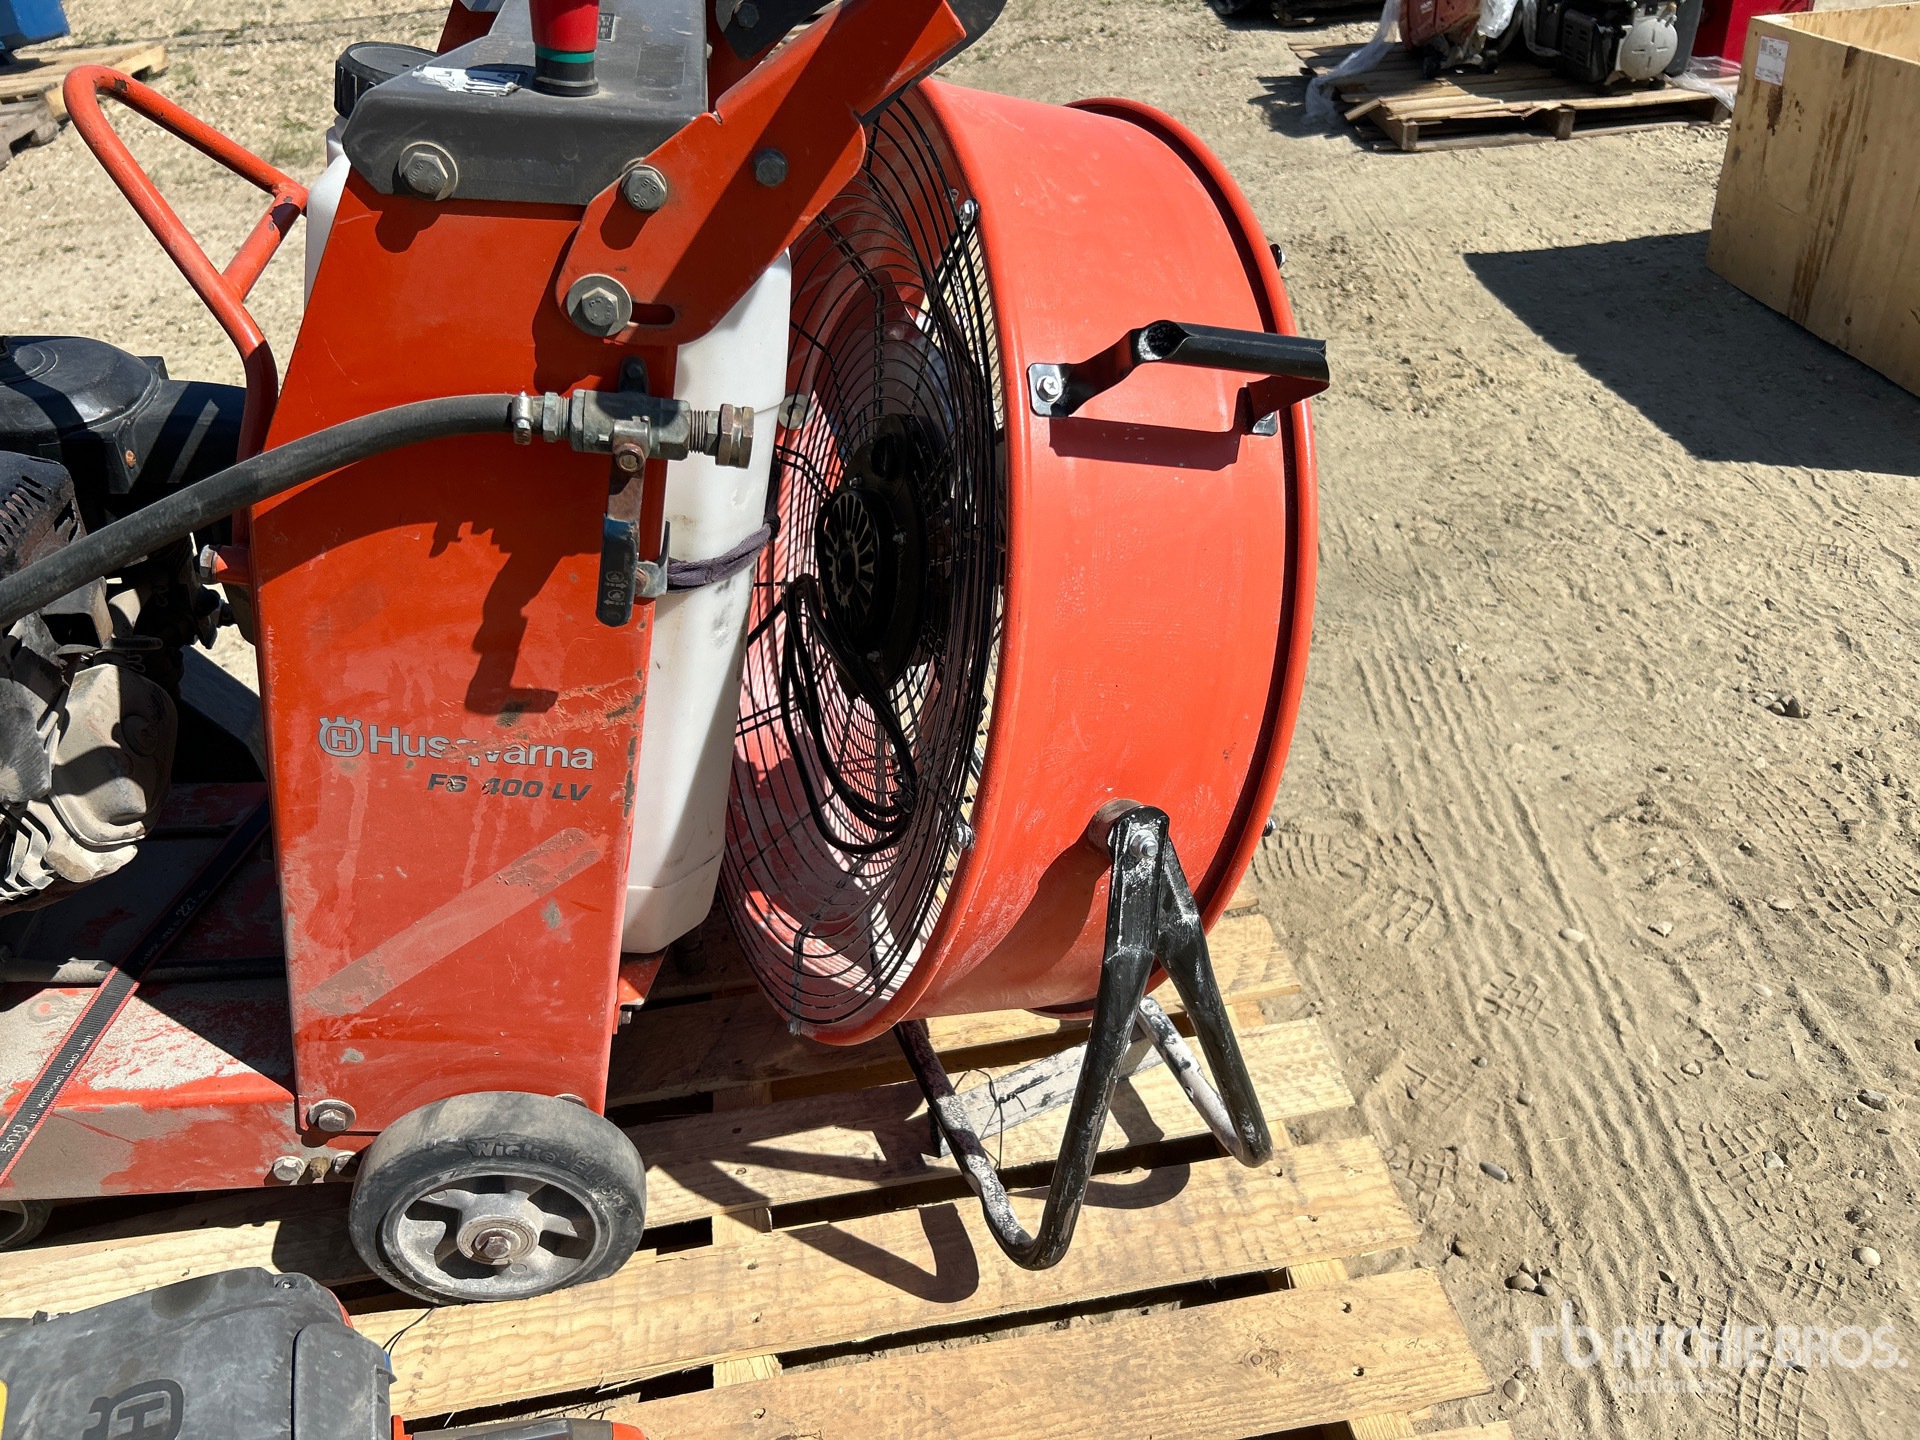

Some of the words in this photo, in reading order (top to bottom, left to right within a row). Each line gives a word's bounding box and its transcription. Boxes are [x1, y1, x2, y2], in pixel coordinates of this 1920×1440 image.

[427, 773, 468, 793] FS
[482, 777, 544, 798] 400
[552, 782, 593, 801] LV
[0, 1124, 28, 1153] 500
[37, 1074, 65, 1108] WORKING
[63, 1053, 80, 1073] LOAD
